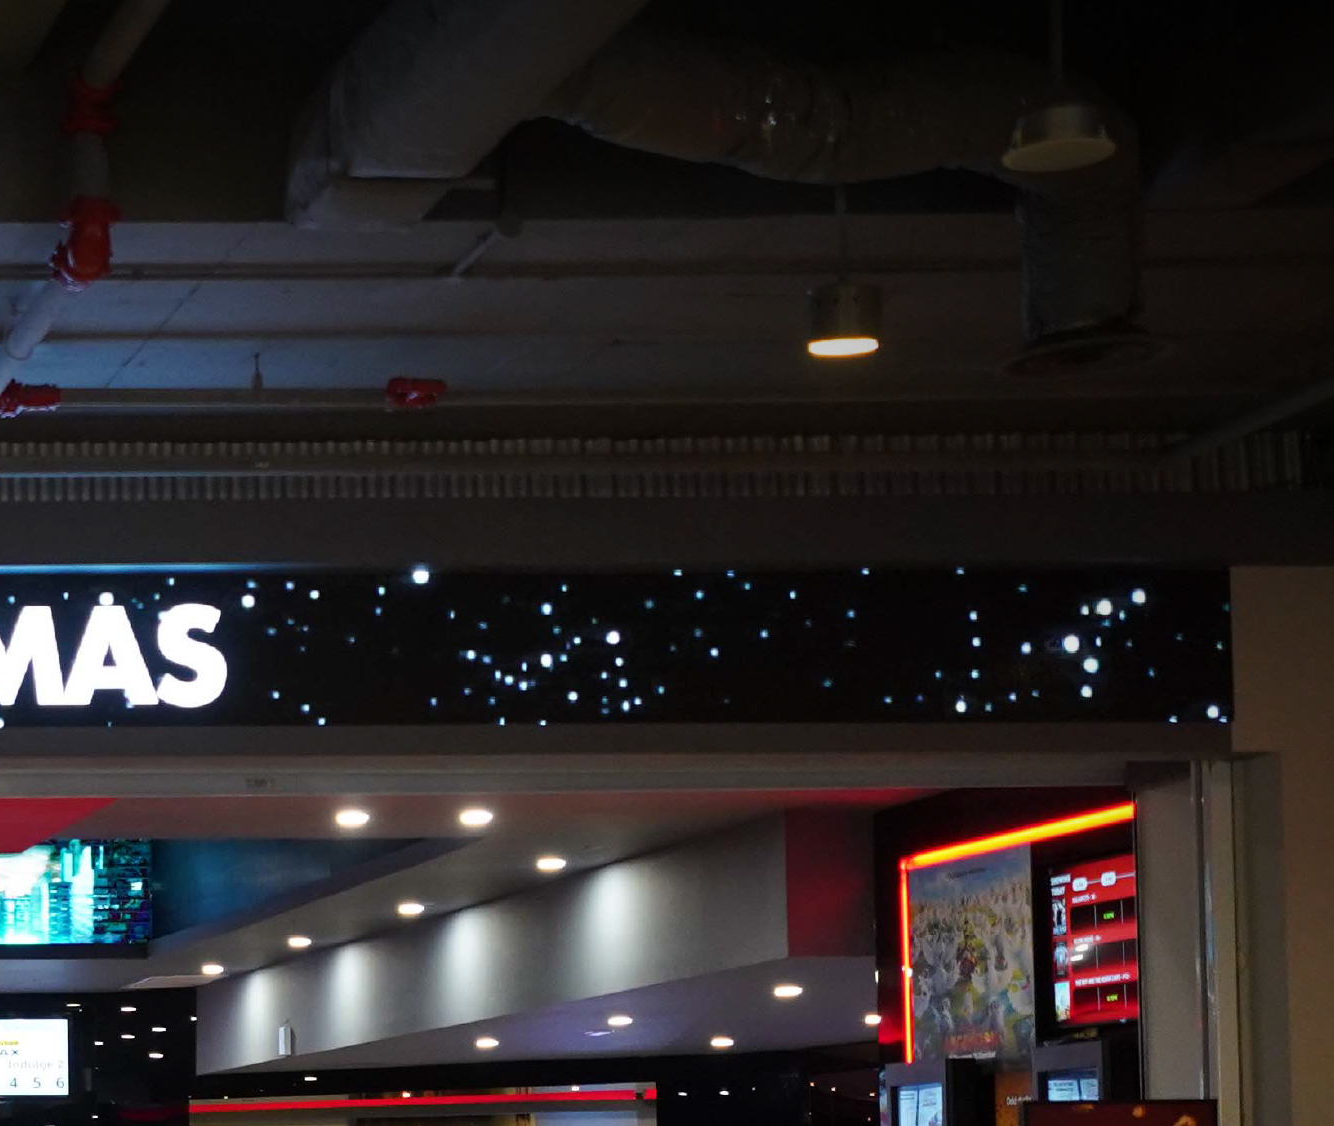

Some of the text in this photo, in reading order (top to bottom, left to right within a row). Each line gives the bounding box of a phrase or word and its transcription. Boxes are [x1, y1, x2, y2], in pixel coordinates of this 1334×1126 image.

[9, 1078, 18, 1088] 4
[32, 1077, 42, 1088] 5
[56, 1077, 65, 1088] 6
